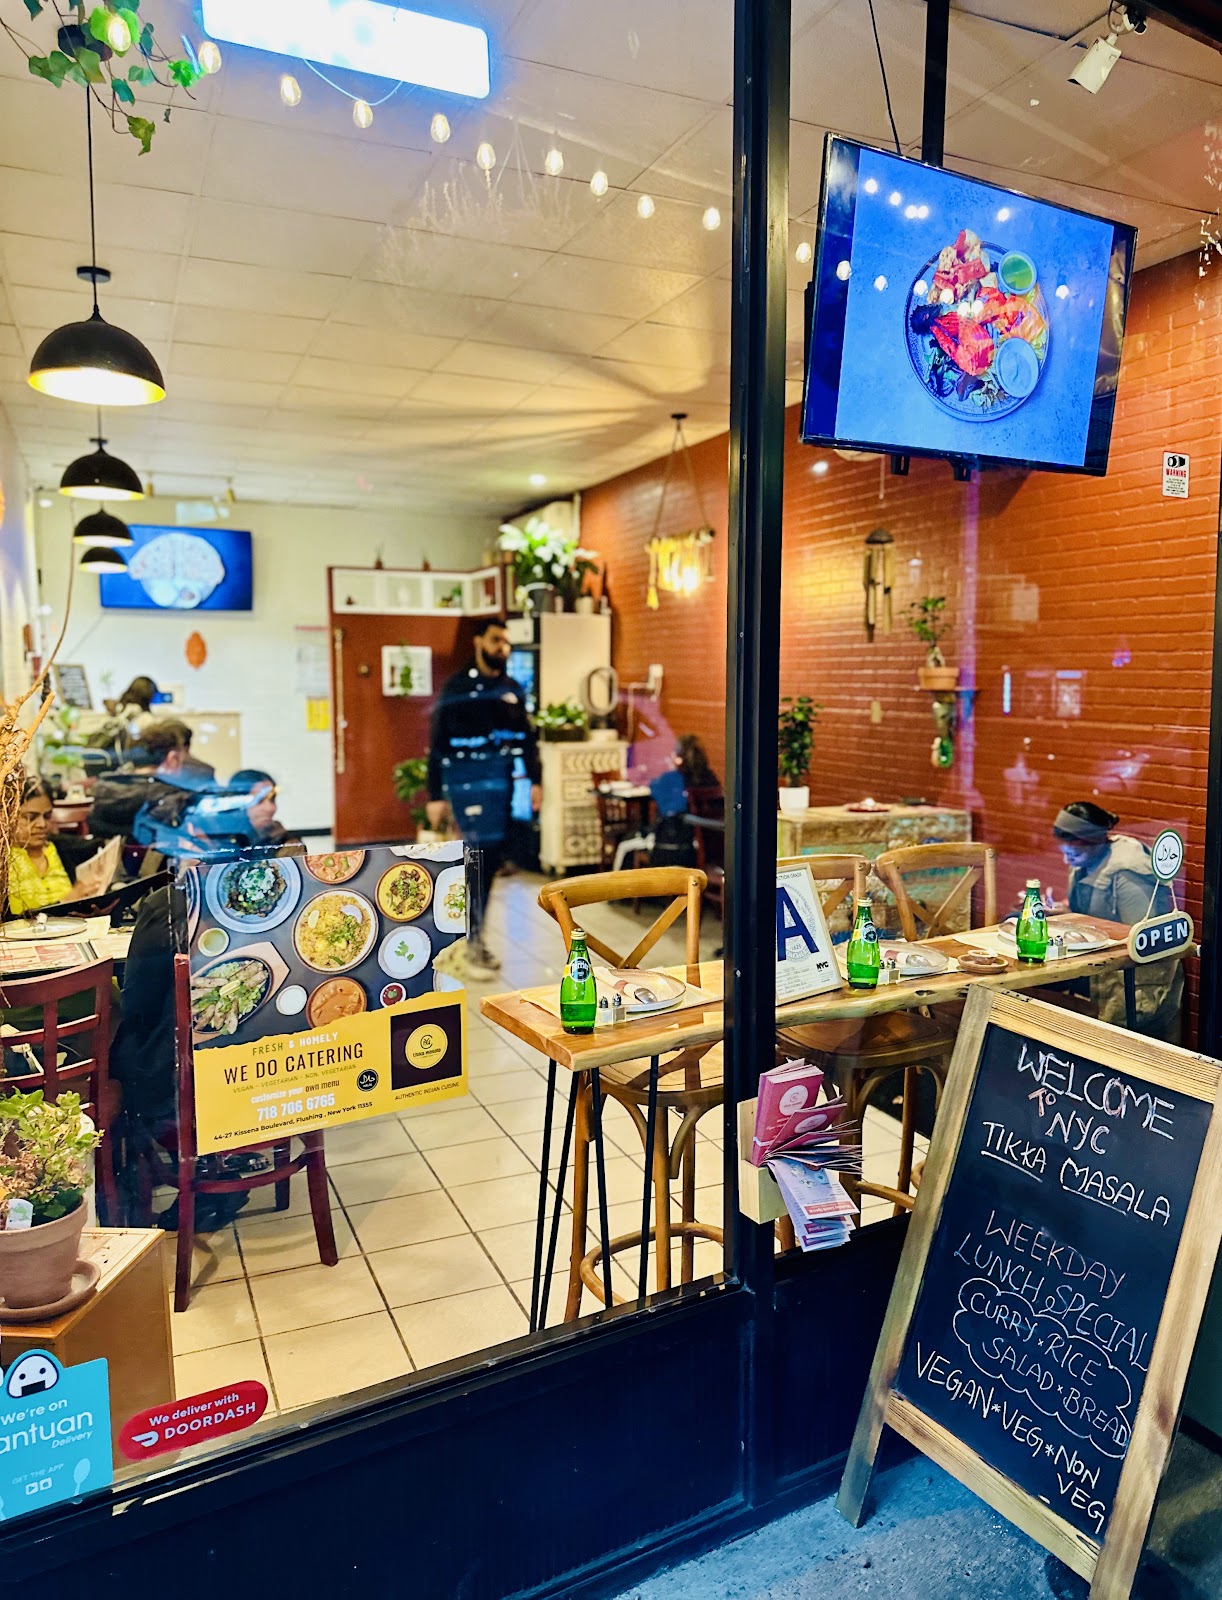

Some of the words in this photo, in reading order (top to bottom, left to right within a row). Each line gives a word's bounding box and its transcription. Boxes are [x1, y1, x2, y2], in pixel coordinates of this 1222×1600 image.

[1157, 844, 1178, 861] حلال
[776, 886, 820, 962] A
[1135, 921, 1188, 951] OPEN
[816, 961, 829, 970] NYC
[224, 1065, 248, 1084] WE
[256, 1059, 277, 1079] DO
[285, 1042, 363, 1072] CATERING
[252, 1042, 284, 1056] FRESH
[299, 1032, 338, 1047] HOMELY
[232, 1084, 254, 1094] VEGAN
[261, 1075, 299, 1088] VEGETARIAN
[321, 1064, 357, 1076] VEGETARIAN
[250, 1090, 287, 1104] customize
[288, 1086, 303, 1098] your
[305, 1083, 320, 1093] own
[321, 1079, 340, 1091] menu
[395, 1090, 422, 1101] AUTHENTIC
[423, 1086, 441, 1095] INDIAN
[1017, 1043, 1175, 1140] WELCOME
[213, 1131, 233, 1141] 44-27
[233, 1125, 260, 1137] Kissena
[260, 1118, 295, 1131] Boulevard,
[327, 1108, 341, 1117] New
[341, 1104, 357, 1114] York
[257, 1106, 278, 1122] 718
[280, 1100, 303, 1117] 706
[306, 1093, 336, 1112] 6765
[1045, 1110, 1110, 1154] NYC
[983, 1122, 1046, 1173] TIKKA
[1060, 1157, 1170, 1226] MASALA
[985, 1210, 1126, 1298] WEEKDAY
[954, 1233, 1044, 1302] LUNCH
[1039, 1284, 1148, 1371] SPECIAL
[971, 1292, 1037, 1342] CURRY
[1045, 1333, 1101, 1386] RICE
[917, 1341, 994, 1419] VEGAN
[983, 1338, 1053, 1390] SALAD
[1063, 1387, 1128, 1447] BREAD
[48, 1399, 68, 1411] on
[149, 1414, 169, 1427] We
[172, 1402, 213, 1420] deliver
[214, 1393, 239, 1408] with
[164, 1401, 256, 1440] DOORDASH
[0, 1411, 93, 1454] antuan
[51, 1430, 92, 1449] Delivery
[12, 1475, 29, 1485] GET
[30, 1469, 47, 1479] THE
[48, 1463, 64, 1474] APP
[1057, 1473, 1105, 1534] VEG
